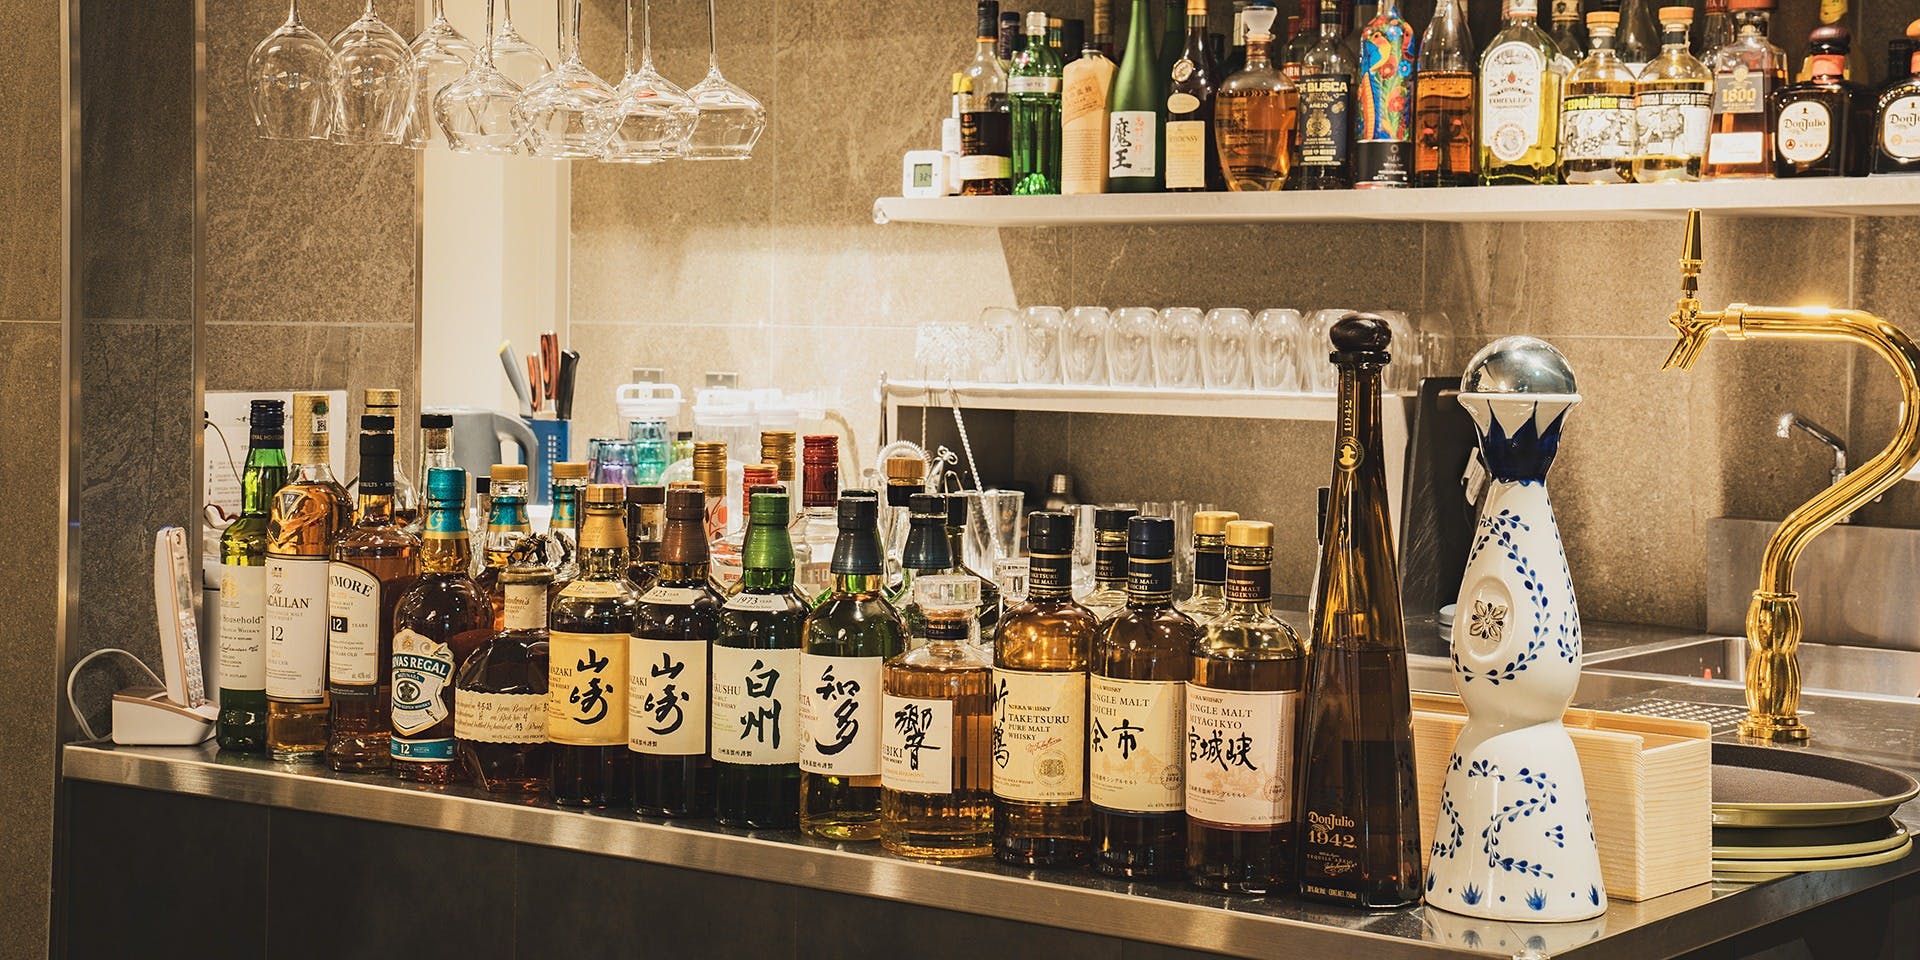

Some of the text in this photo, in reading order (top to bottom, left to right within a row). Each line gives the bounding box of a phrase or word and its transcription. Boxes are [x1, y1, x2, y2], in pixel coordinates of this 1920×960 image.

[1307, 81, 1348, 92] BUSCA
[1722, 87, 1758, 103] 1800
[1112, 117, 1132, 170] 魔王
[1343, 400, 1353, 432] 1942
[736, 595, 759, 605] 1973
[332, 618, 342, 631] 12
[271, 625, 284, 642] 12
[410, 657, 448, 677] REGAL
[569, 648, 614, 725] 山崎
[644, 652, 690, 736] 山崎
[740, 659, 782, 750] 白州
[814, 664, 861, 756] 知多
[1119, 697, 1151, 708] MALT
[1008, 713, 1070, 725] TAKETSURU
[1220, 708, 1253, 718] MALT
[894, 703, 941, 771] 響
[1008, 724, 1051, 733] PURE MALT
[1008, 732, 1037, 741] WHISKY
[1090, 716, 1145, 760] 余市
[400, 743, 410, 754] 12
[1308, 830, 1356, 849] 1942
